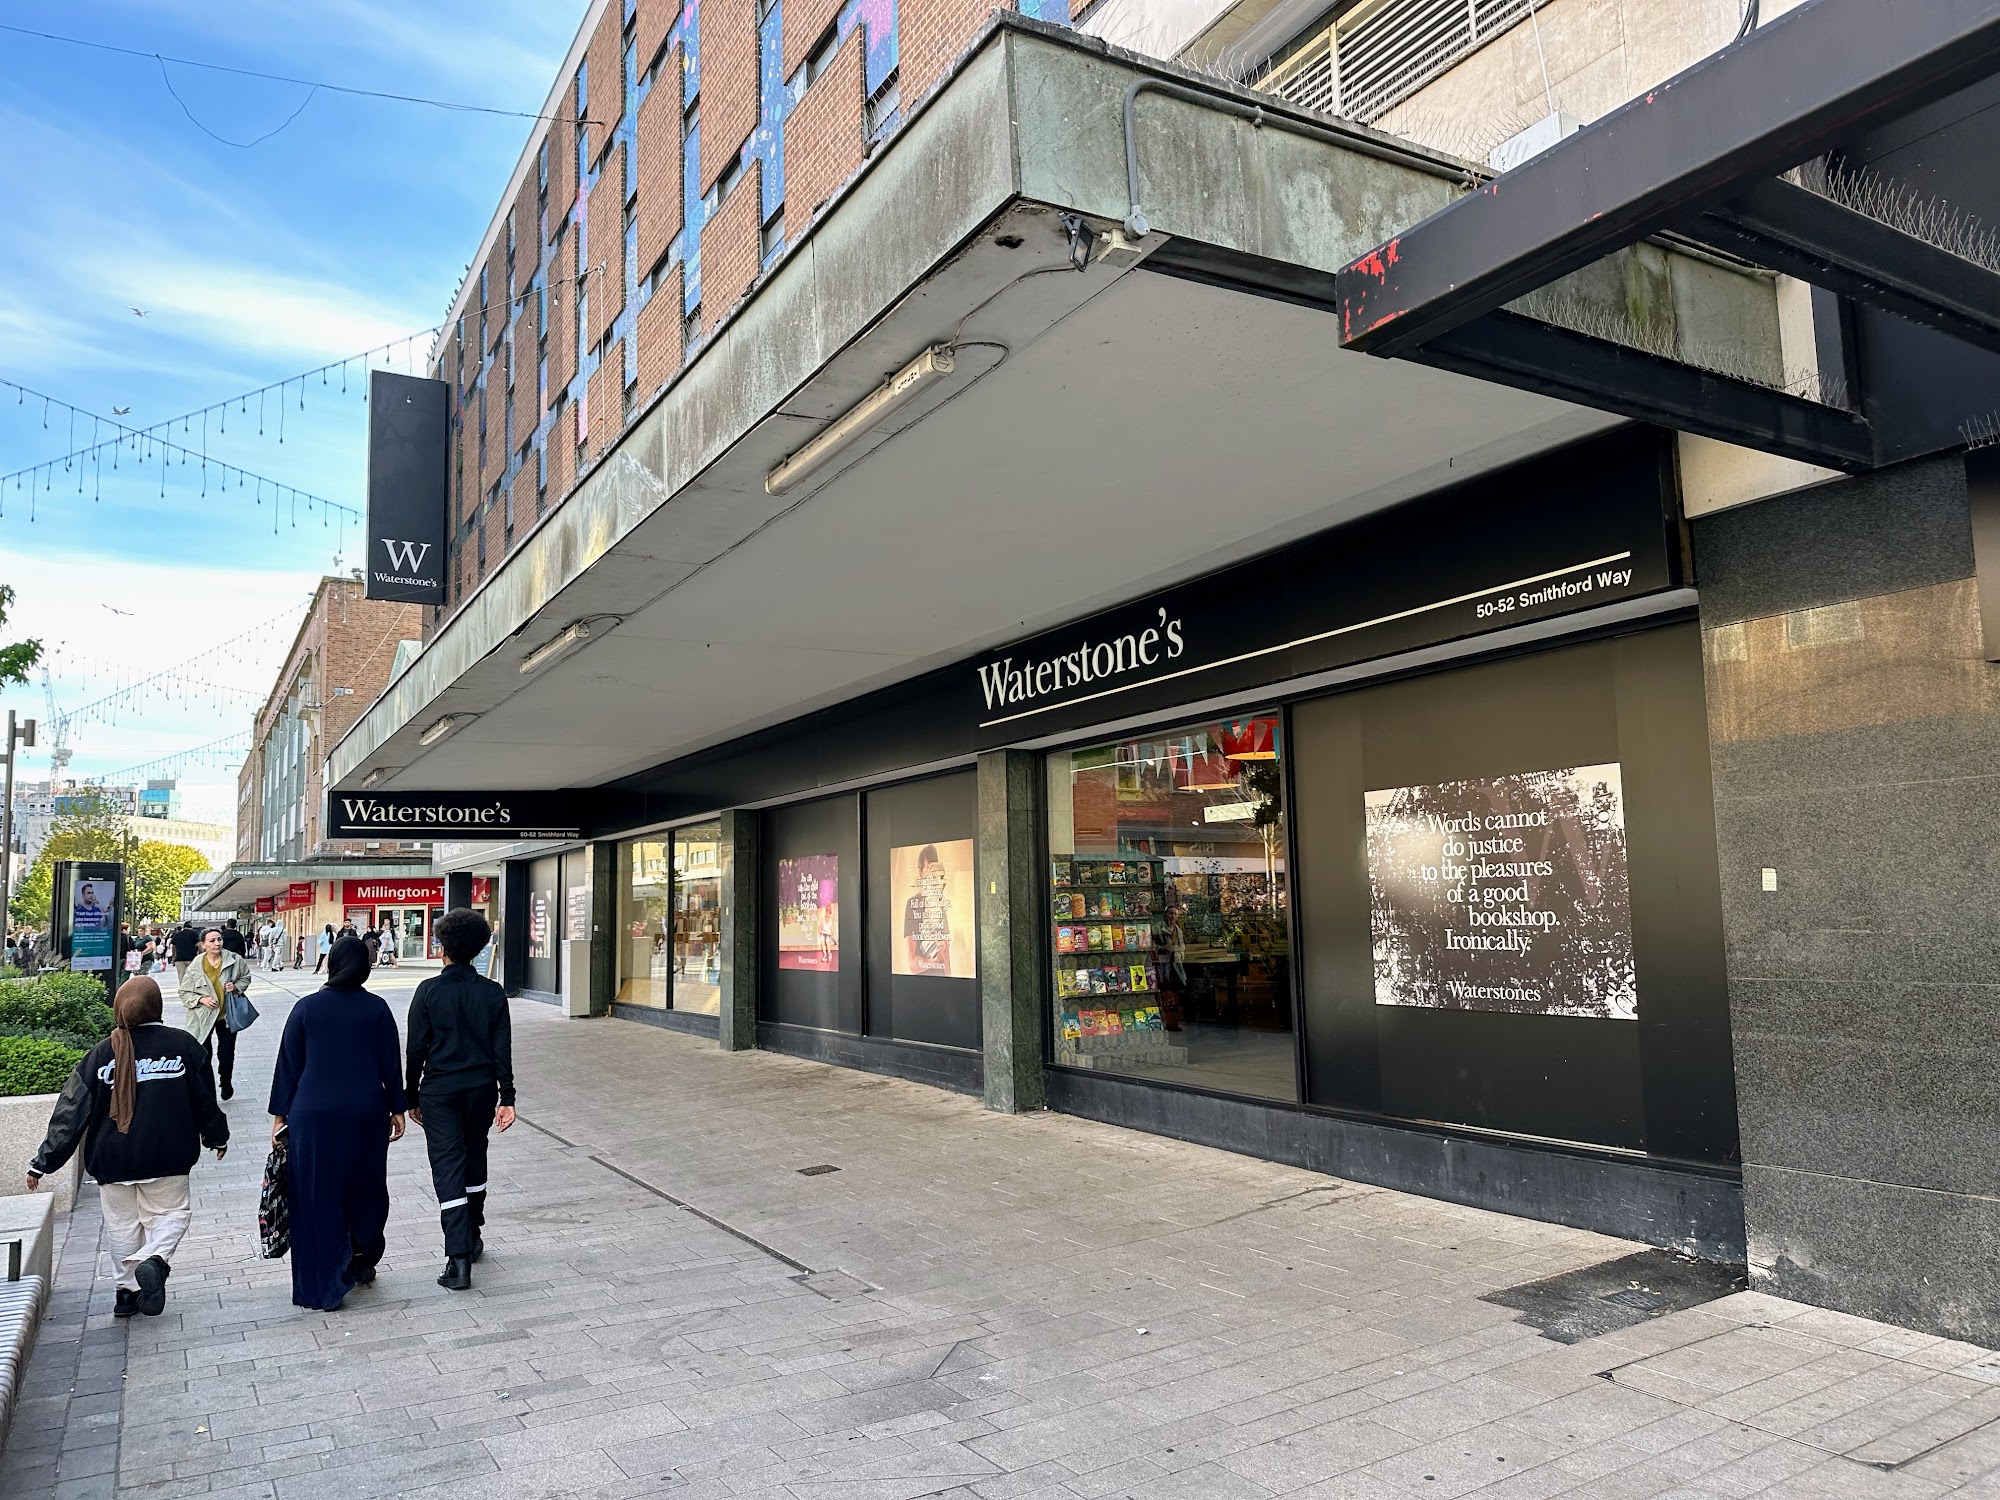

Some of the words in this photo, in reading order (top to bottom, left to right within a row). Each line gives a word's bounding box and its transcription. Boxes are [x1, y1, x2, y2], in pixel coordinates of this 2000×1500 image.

[381, 539, 431, 574] W
[375, 573, 437, 588] Waterstone's
[1476, 596, 1516, 619] 50-52
[1519, 574, 1593, 608] Smithford
[1596, 568, 1633, 588] Way
[976, 606, 1185, 711] Waterstone's
[340, 799, 511, 823] Waterstone's
[1426, 810, 1482, 837] Words
[1484, 808, 1550, 831] cannot
[566, 831, 580, 839] Way
[1442, 835, 1465, 857] do
[1465, 831, 1524, 862] justice
[1420, 862, 1438, 881] to
[1441, 858, 1468, 880] the
[1470, 857, 1554, 886] pleasures
[357, 885, 430, 900] Millington
[1446, 881, 1466, 903] of
[1468, 887, 1480, 903] a
[1483, 879, 1530, 909] good
[1468, 904, 1561, 934] bookshop.
[1444, 928, 1532, 958] Ironically.
[1447, 980, 1542, 1002] Waterstones
